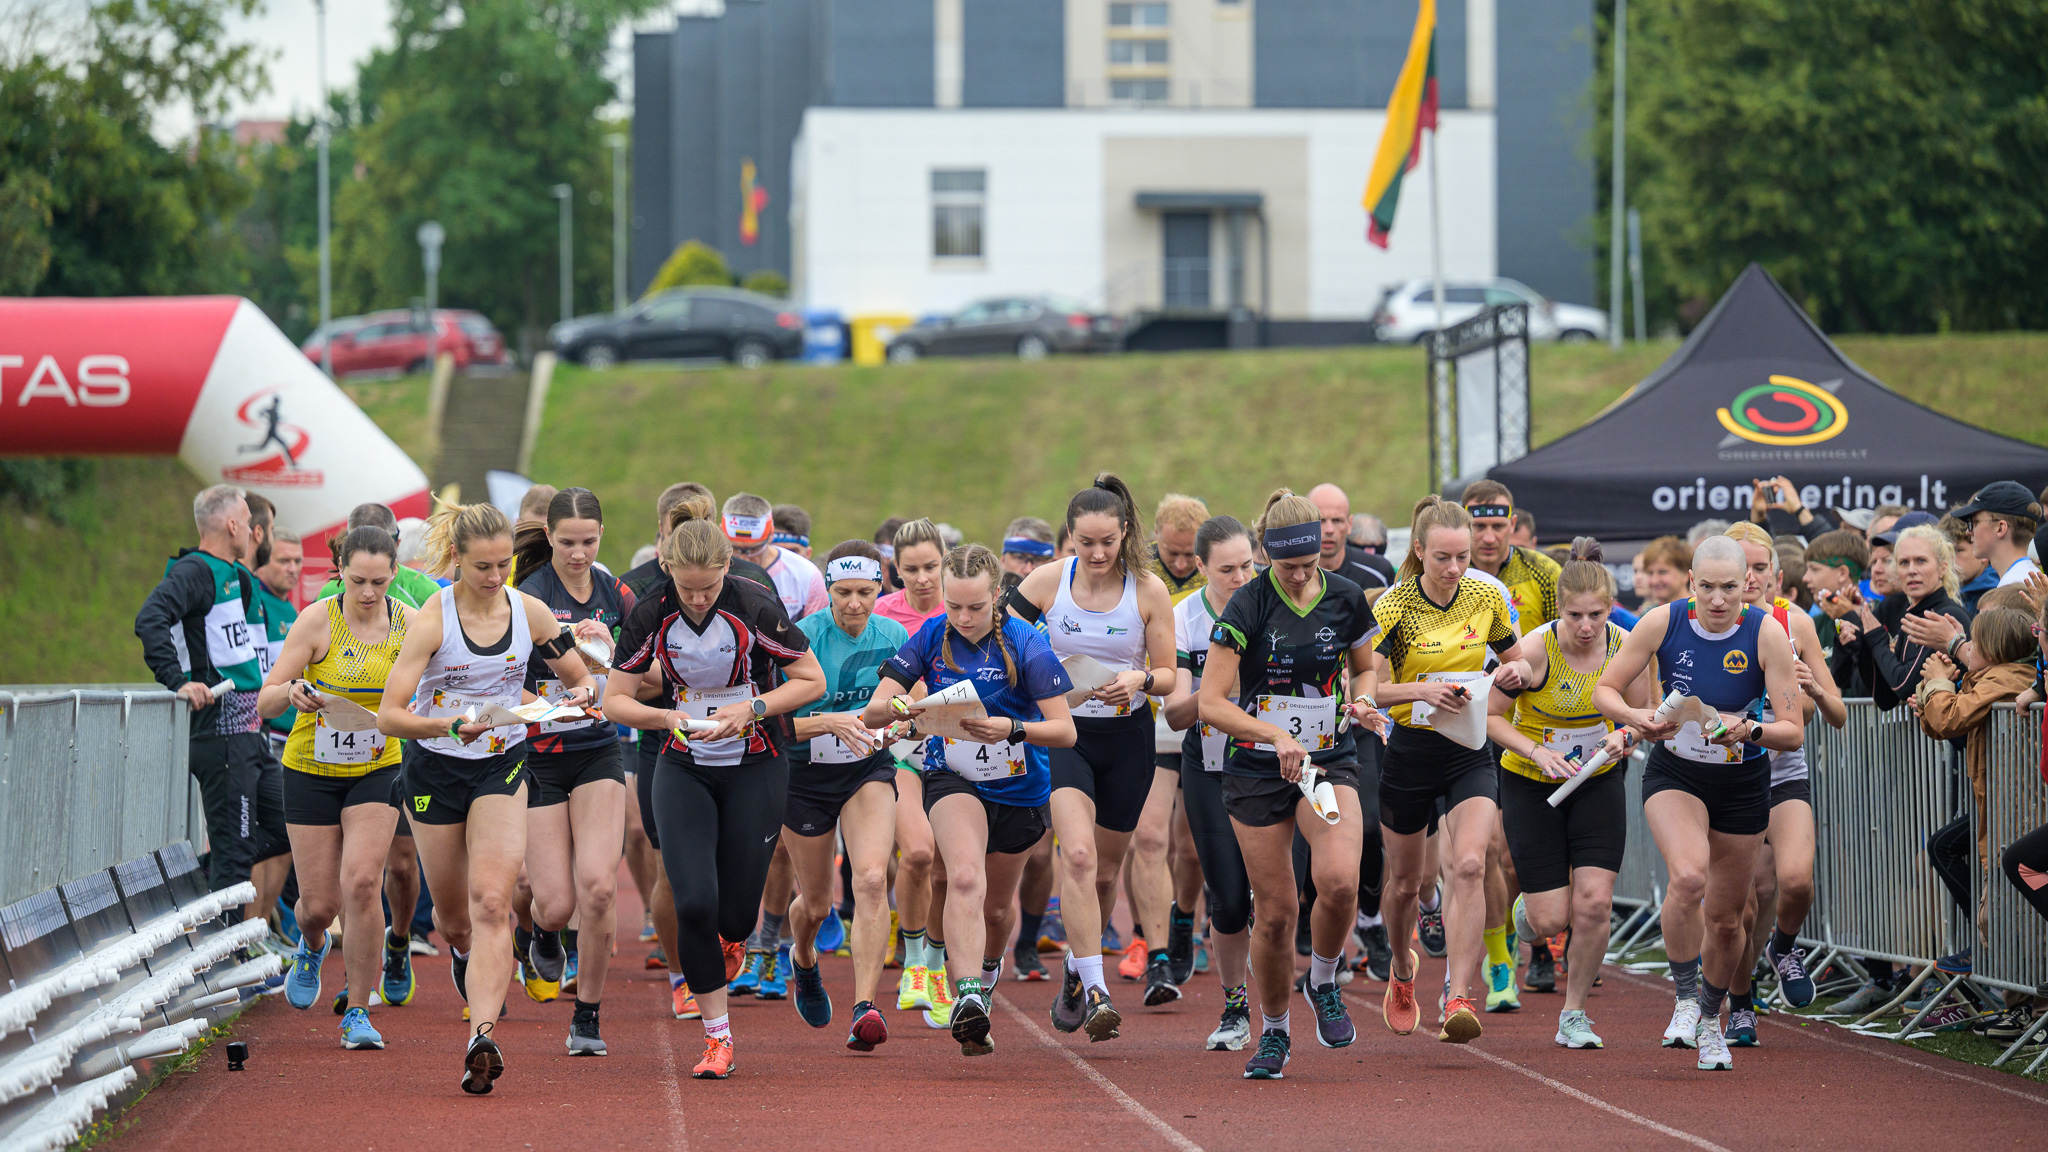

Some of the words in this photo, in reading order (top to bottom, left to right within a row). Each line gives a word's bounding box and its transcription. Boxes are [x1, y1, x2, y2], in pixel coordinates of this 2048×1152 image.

[1651, 475, 1947, 512] orienering.lt
[1268, 535, 1316, 548] FRENSON
[840, 561, 862, 570] WM
[444, 664, 471, 672] TRIMTEX
[703, 690, 744, 699] ORIENTEERING.LT
[1288, 716, 1302, 736] 3
[330, 731, 356, 749] 14
[975, 744, 990, 764] 4
[959, 981, 981, 991] GAJA
